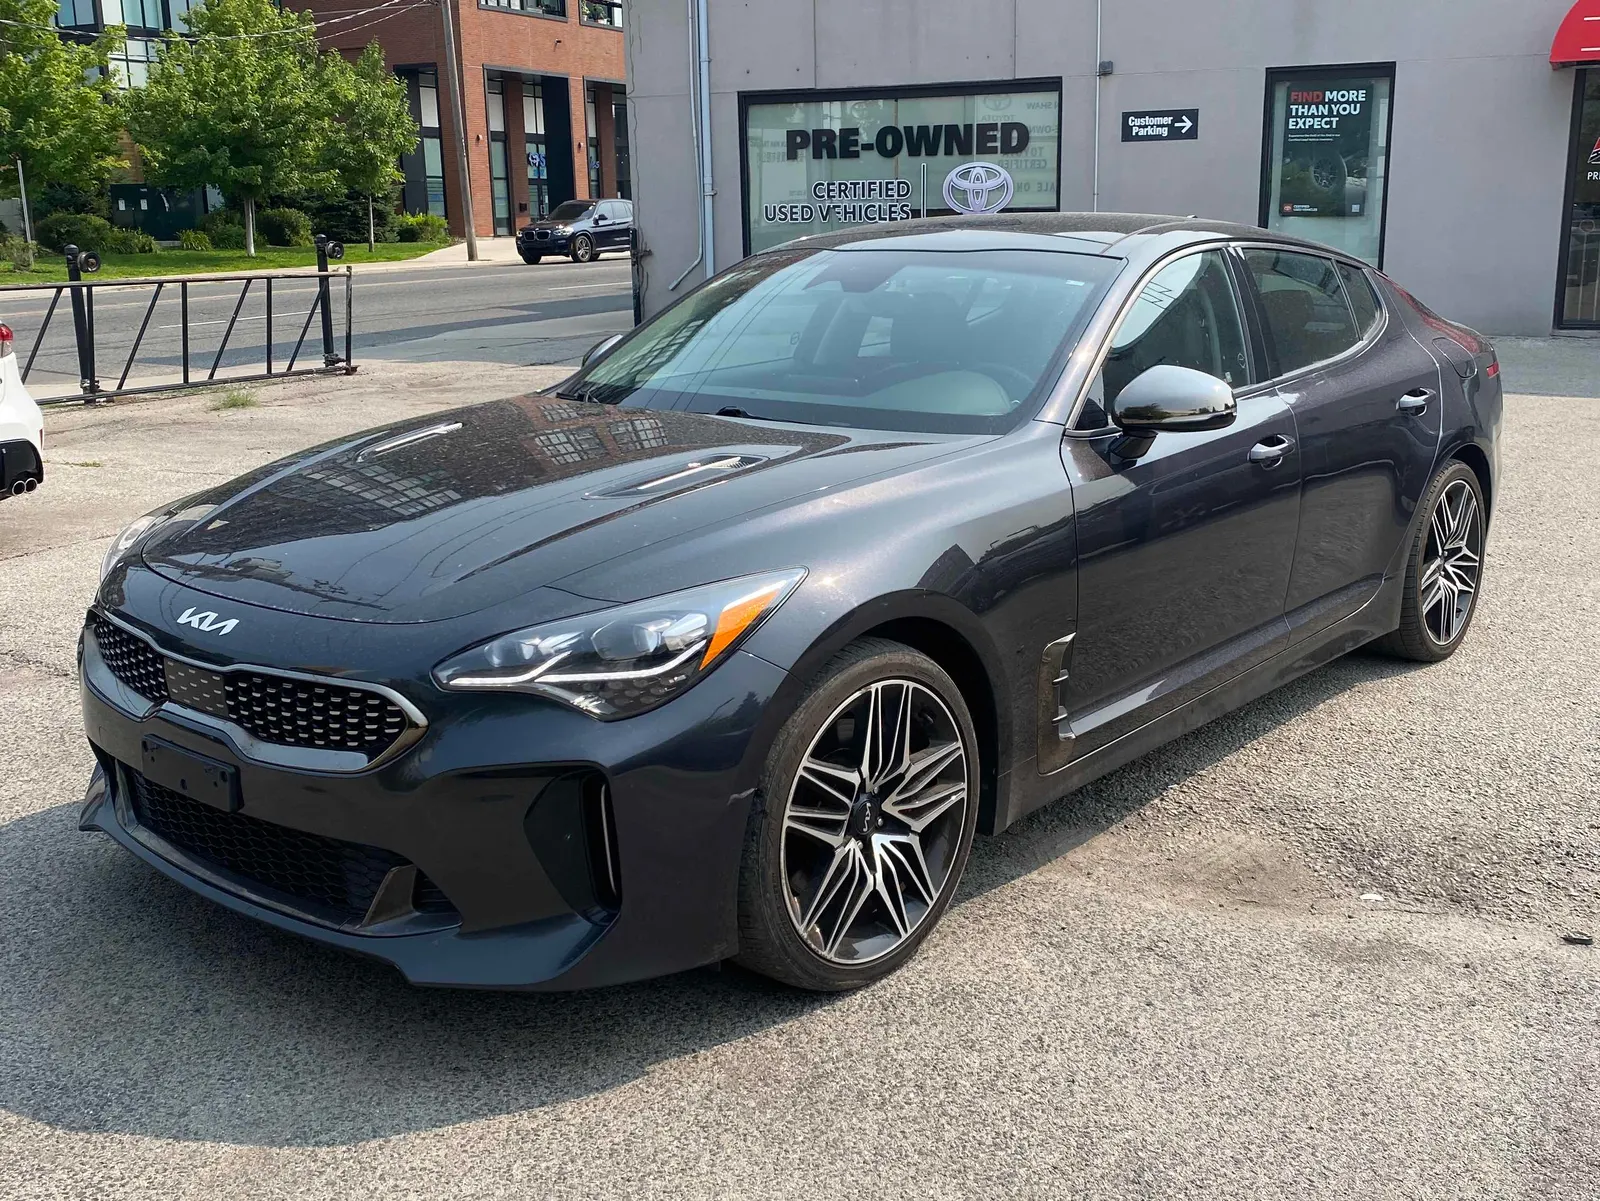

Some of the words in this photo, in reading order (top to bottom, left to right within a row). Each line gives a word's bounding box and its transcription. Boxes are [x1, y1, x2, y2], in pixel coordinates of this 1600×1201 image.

[1290, 90, 1324, 103] FIND
[1324, 89, 1367, 102] MORE
[1289, 103, 1329, 116] THAN
[1330, 103, 1361, 116] YOU
[1128, 115, 1174, 126] Customer
[1288, 117, 1340, 129] EXPECT
[1132, 126, 1169, 137] Parking
[786, 121, 1030, 160] PRE-OWNED
[1587, 171, 1600, 181] PR
[812, 179, 912, 201] CERTIFIED
[763, 203, 814, 223] USED
[176, 606, 240, 636] KIA
